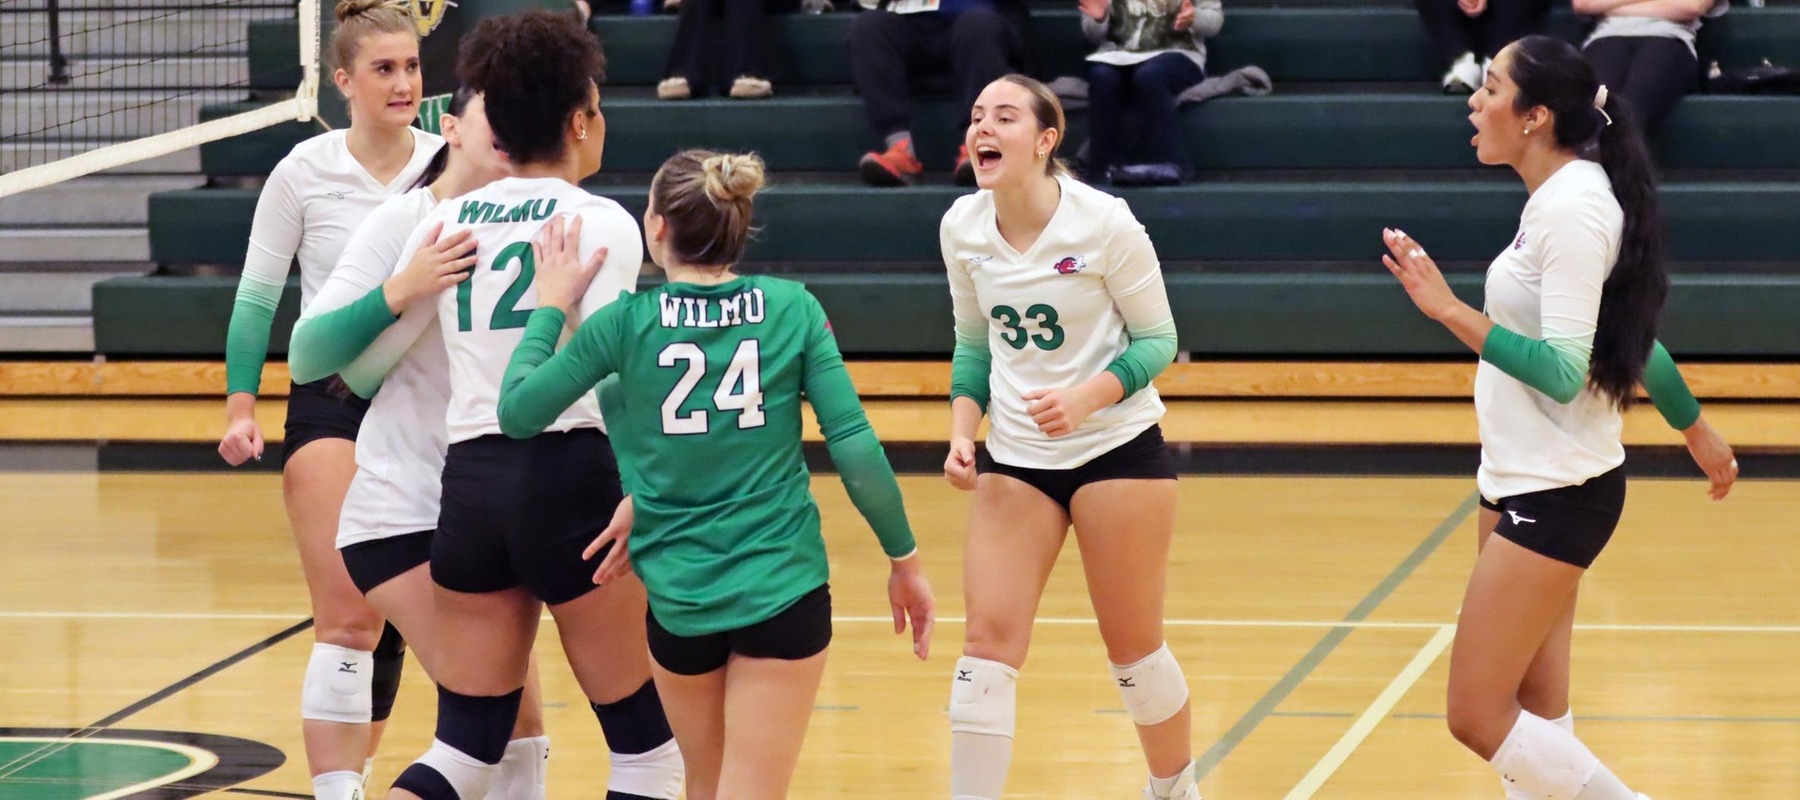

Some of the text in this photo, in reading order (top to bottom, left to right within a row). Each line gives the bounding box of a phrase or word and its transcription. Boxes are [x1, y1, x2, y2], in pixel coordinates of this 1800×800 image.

[458, 199, 557, 224] WILMU
[457, 241, 536, 332] 12
[659, 287, 766, 328] WILMU
[991, 303, 1065, 351] 33
[657, 338, 766, 436] 24
